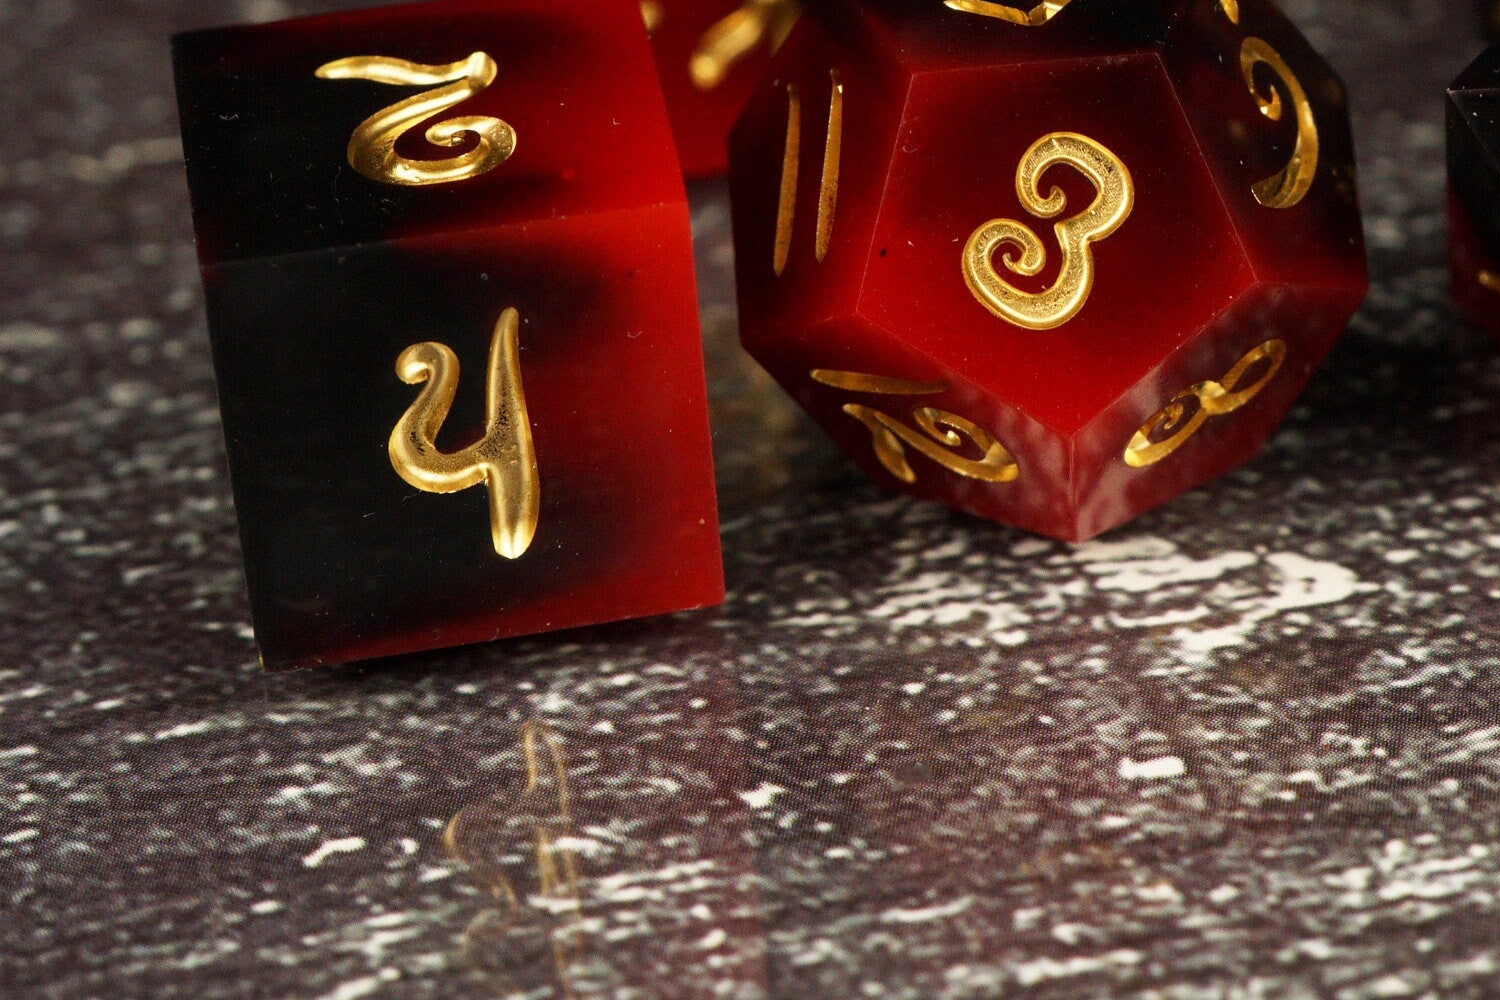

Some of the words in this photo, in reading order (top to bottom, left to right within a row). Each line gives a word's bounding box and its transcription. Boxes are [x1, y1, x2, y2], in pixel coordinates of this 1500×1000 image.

[313, 49, 517, 186] 2
[960, 131, 1135, 330] 3
[388, 306, 541, 560] 4
[1122, 337, 1287, 468] 8
